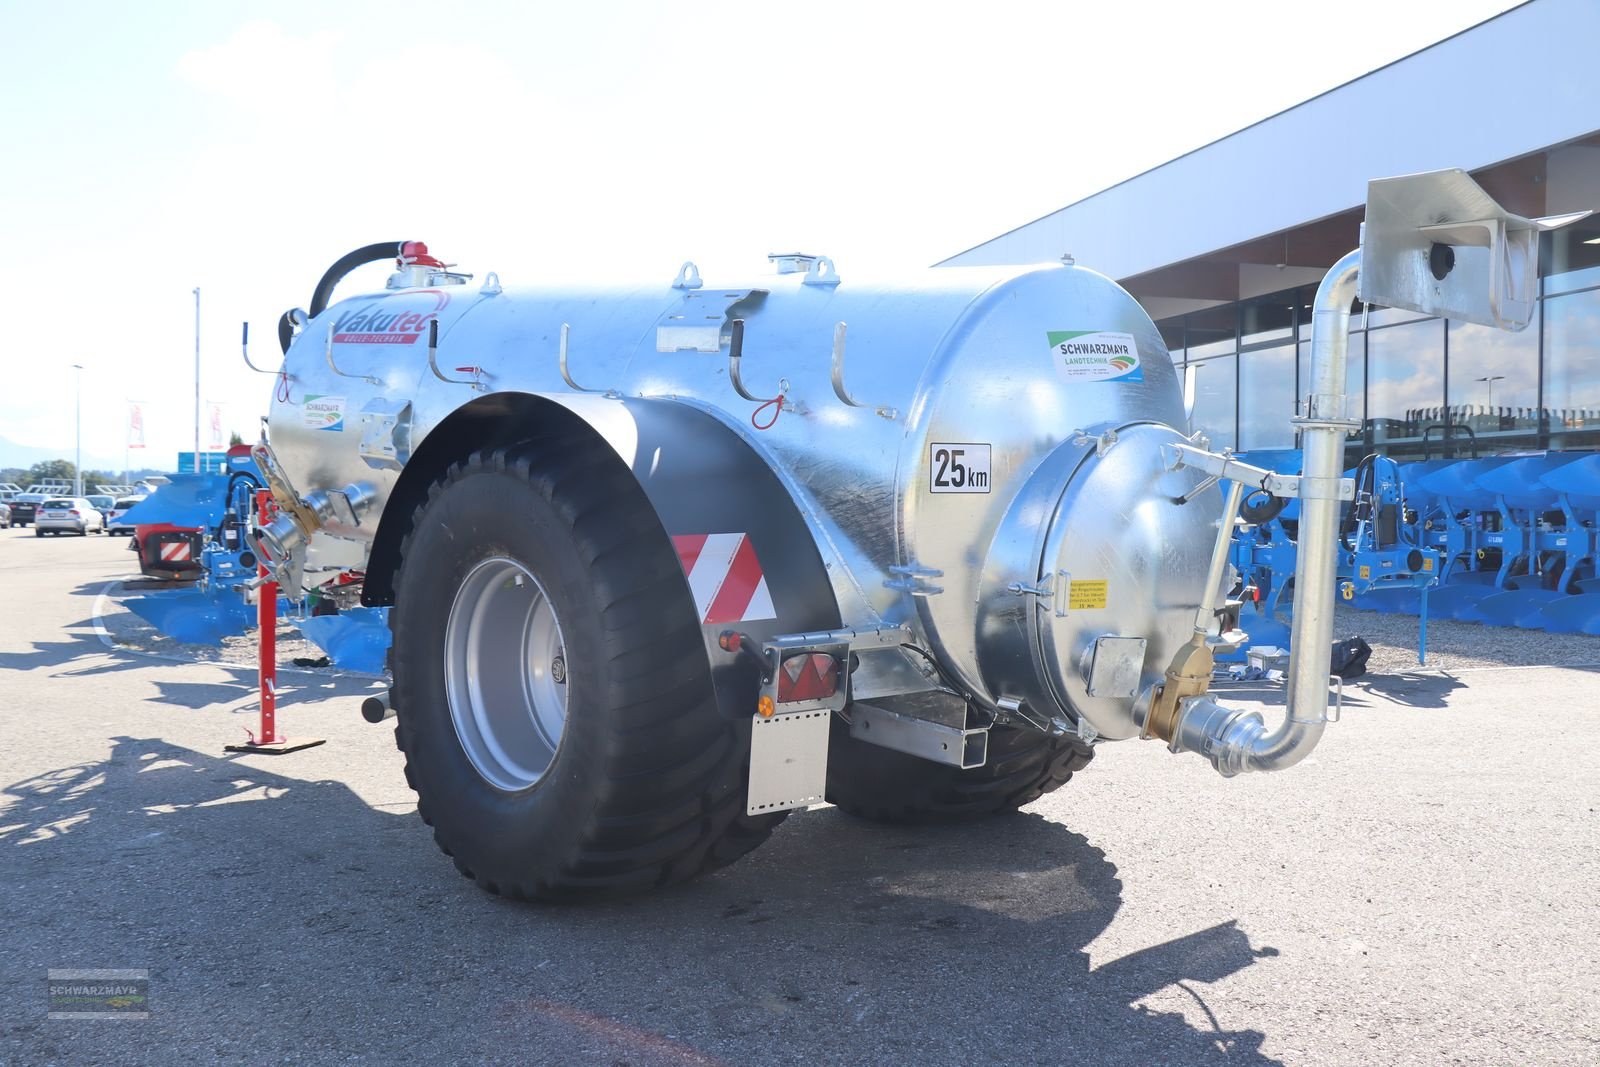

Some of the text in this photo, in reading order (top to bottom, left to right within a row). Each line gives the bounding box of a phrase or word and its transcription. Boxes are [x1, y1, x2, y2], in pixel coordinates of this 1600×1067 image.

[333, 303, 438, 334] Vakutec
[1060, 343, 1129, 355] SCHWARZMAYR
[1064, 357, 1108, 365] LANDTECHNIK
[935, 448, 988, 487] 25 km
